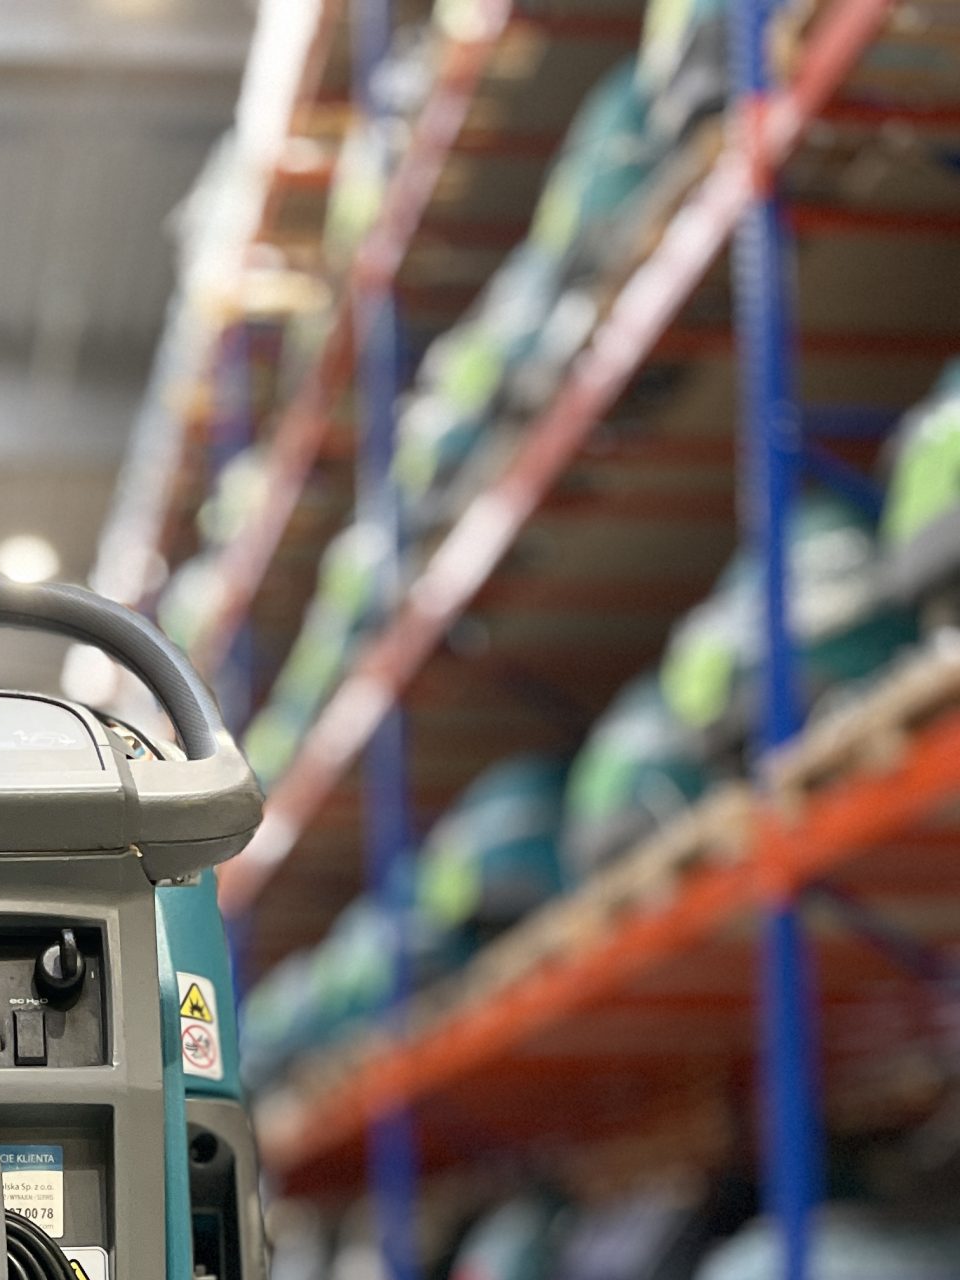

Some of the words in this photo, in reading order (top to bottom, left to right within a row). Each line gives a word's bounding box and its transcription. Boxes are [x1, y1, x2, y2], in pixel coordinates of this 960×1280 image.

[16, 1153, 55, 1164] KLIENTA
[3, 1183, 20, 1191] lska
[24, 1207, 38, 1220] 00
[40, 1207, 54, 1220] 78
